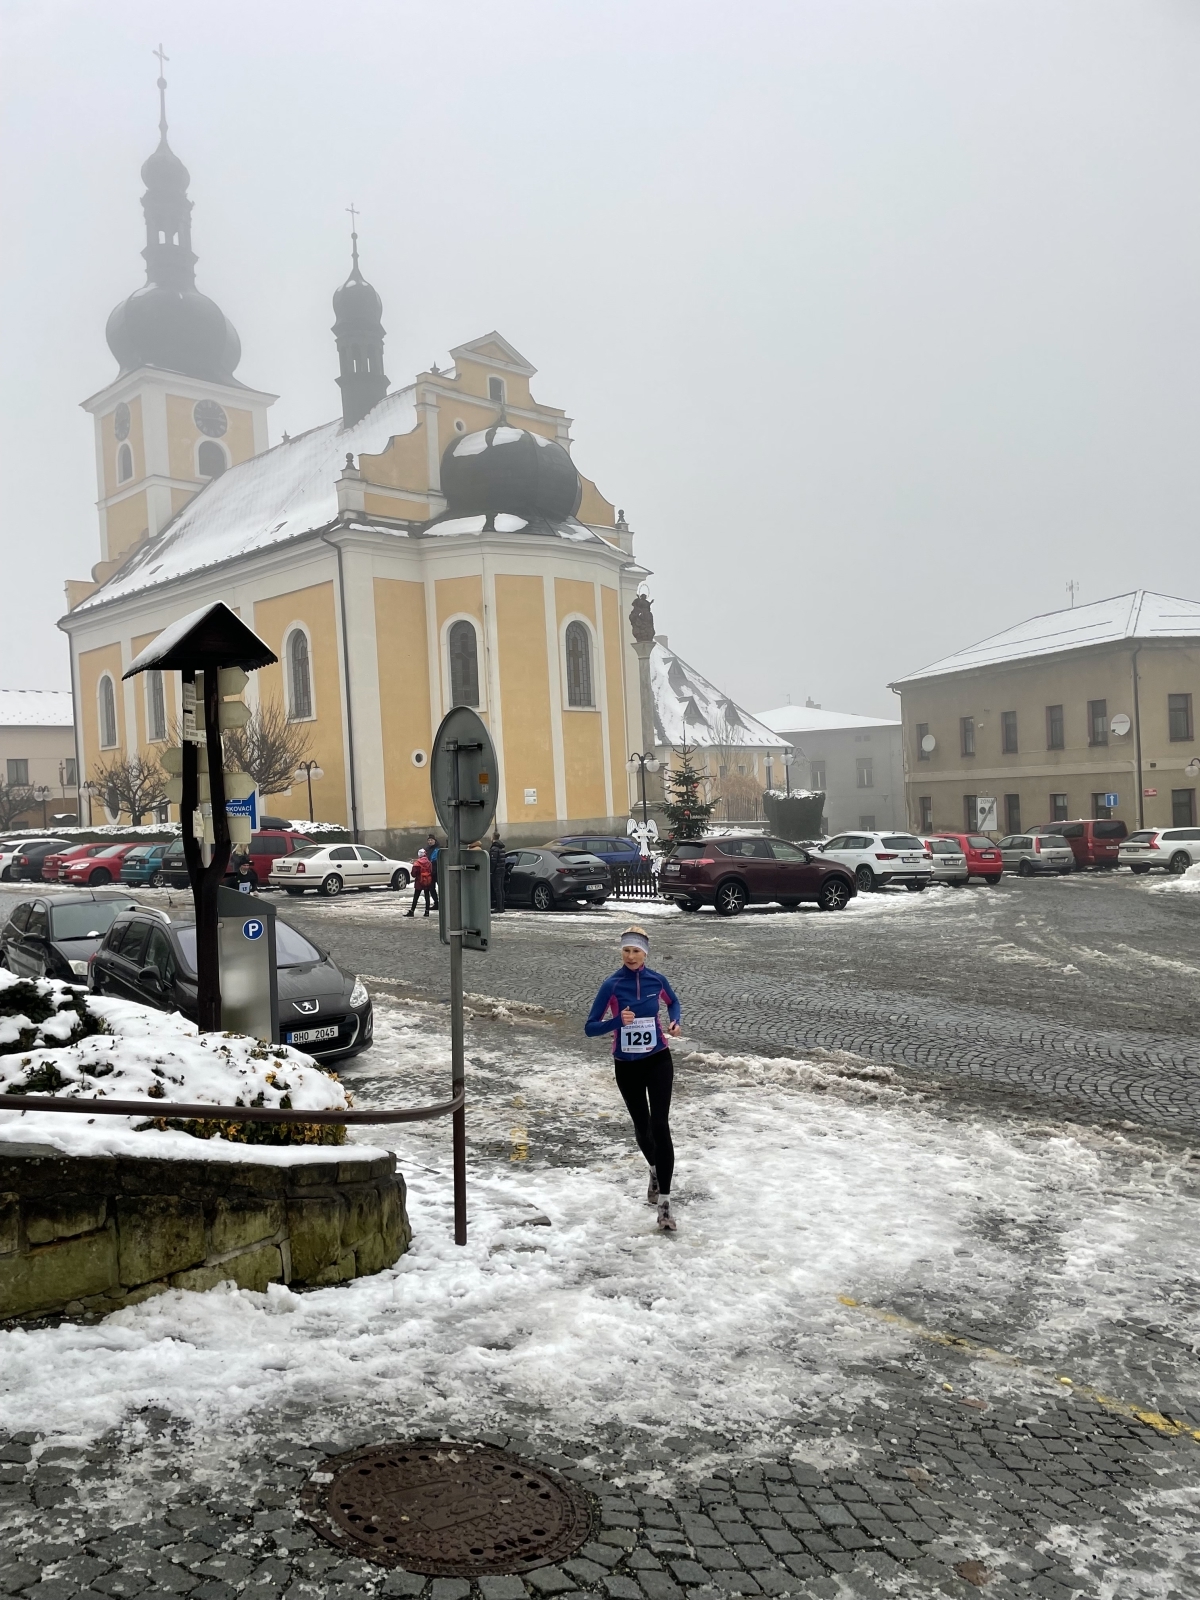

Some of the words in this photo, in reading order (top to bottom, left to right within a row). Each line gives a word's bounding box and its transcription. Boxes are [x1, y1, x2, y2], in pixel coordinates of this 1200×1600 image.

[225, 804, 252, 812] RKOVACÍ
[248, 922, 259, 937] P
[315, 1028, 335, 1038] 2045
[625, 1031, 652, 1046] 129
